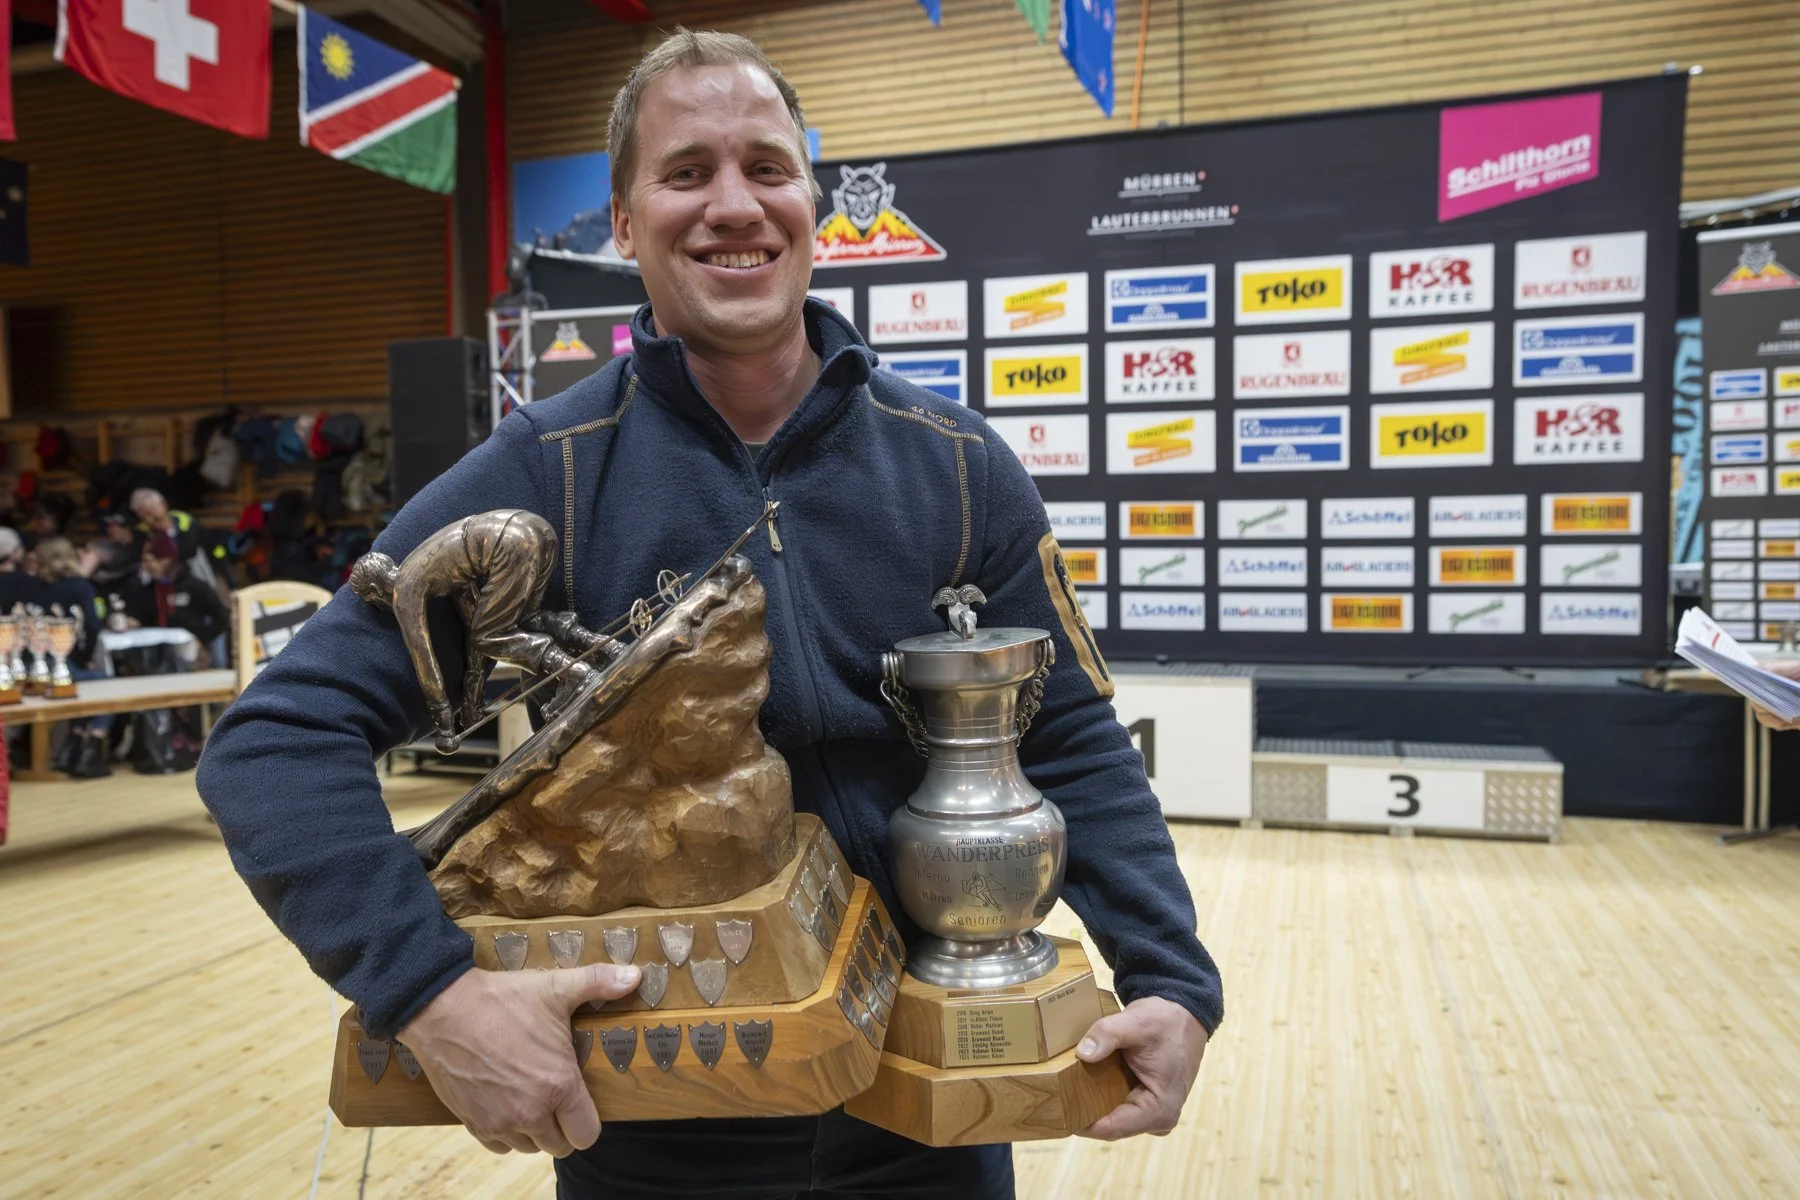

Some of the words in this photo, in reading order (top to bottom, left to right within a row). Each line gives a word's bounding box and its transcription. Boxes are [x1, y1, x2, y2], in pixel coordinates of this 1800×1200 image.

[1447, 134, 1592, 190] Schilthorn
[1091, 205, 1230, 228] LAUTERBRUNNEN
[1388, 292, 1474, 308] KAFFEE
[1122, 381, 1199, 394] KAFFEE
[928, 411, 957, 427] NORD
[1534, 440, 1624, 455] KAFFEE
[1127, 718, 1156, 779] 1
[1386, 774, 1421, 818] 3
[956, 837, 1004, 846] HAUPTKLASSE
[916, 838, 1049, 863] WANDERPREIS
[949, 912, 1007, 926] Senioren
